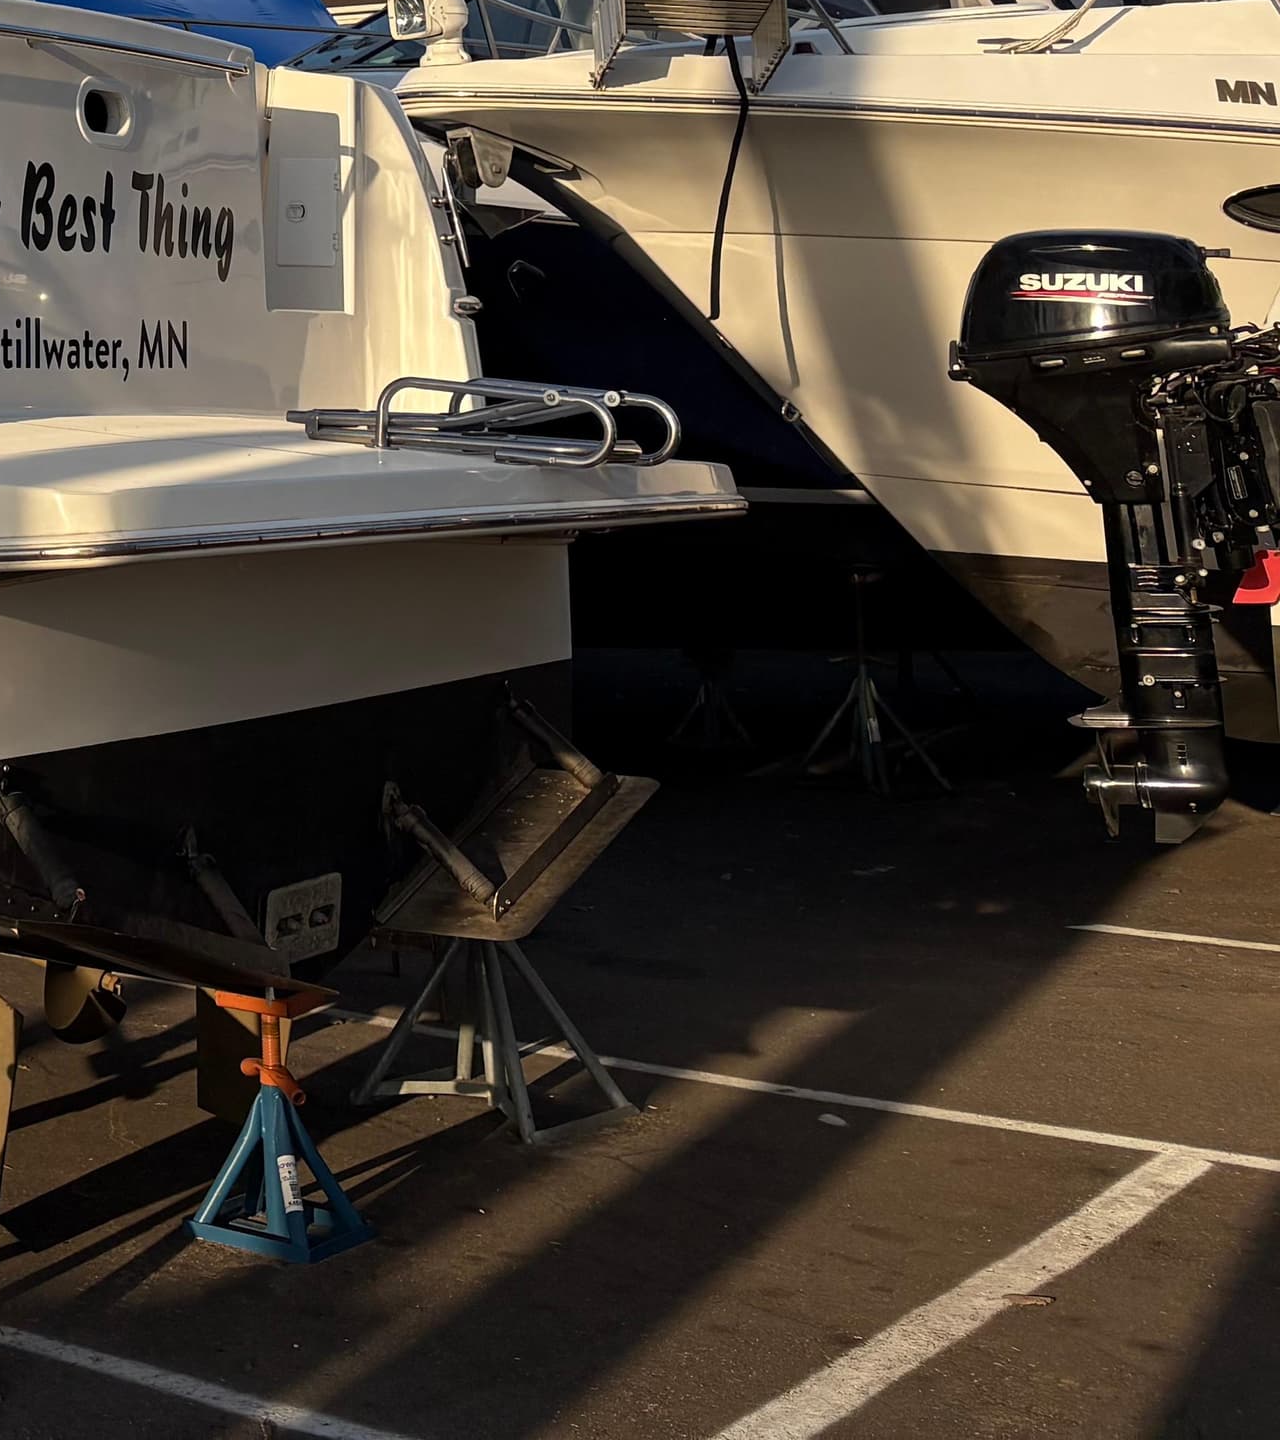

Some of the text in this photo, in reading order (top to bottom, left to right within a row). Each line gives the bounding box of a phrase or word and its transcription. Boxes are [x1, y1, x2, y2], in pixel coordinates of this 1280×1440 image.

[1215, 78, 1278, 106] MN
[20, 160, 116, 254] Best
[130, 170, 235, 283] Thing
[1019, 272, 1144, 292] SUZUKI
[137, 318, 189, 370] MN
